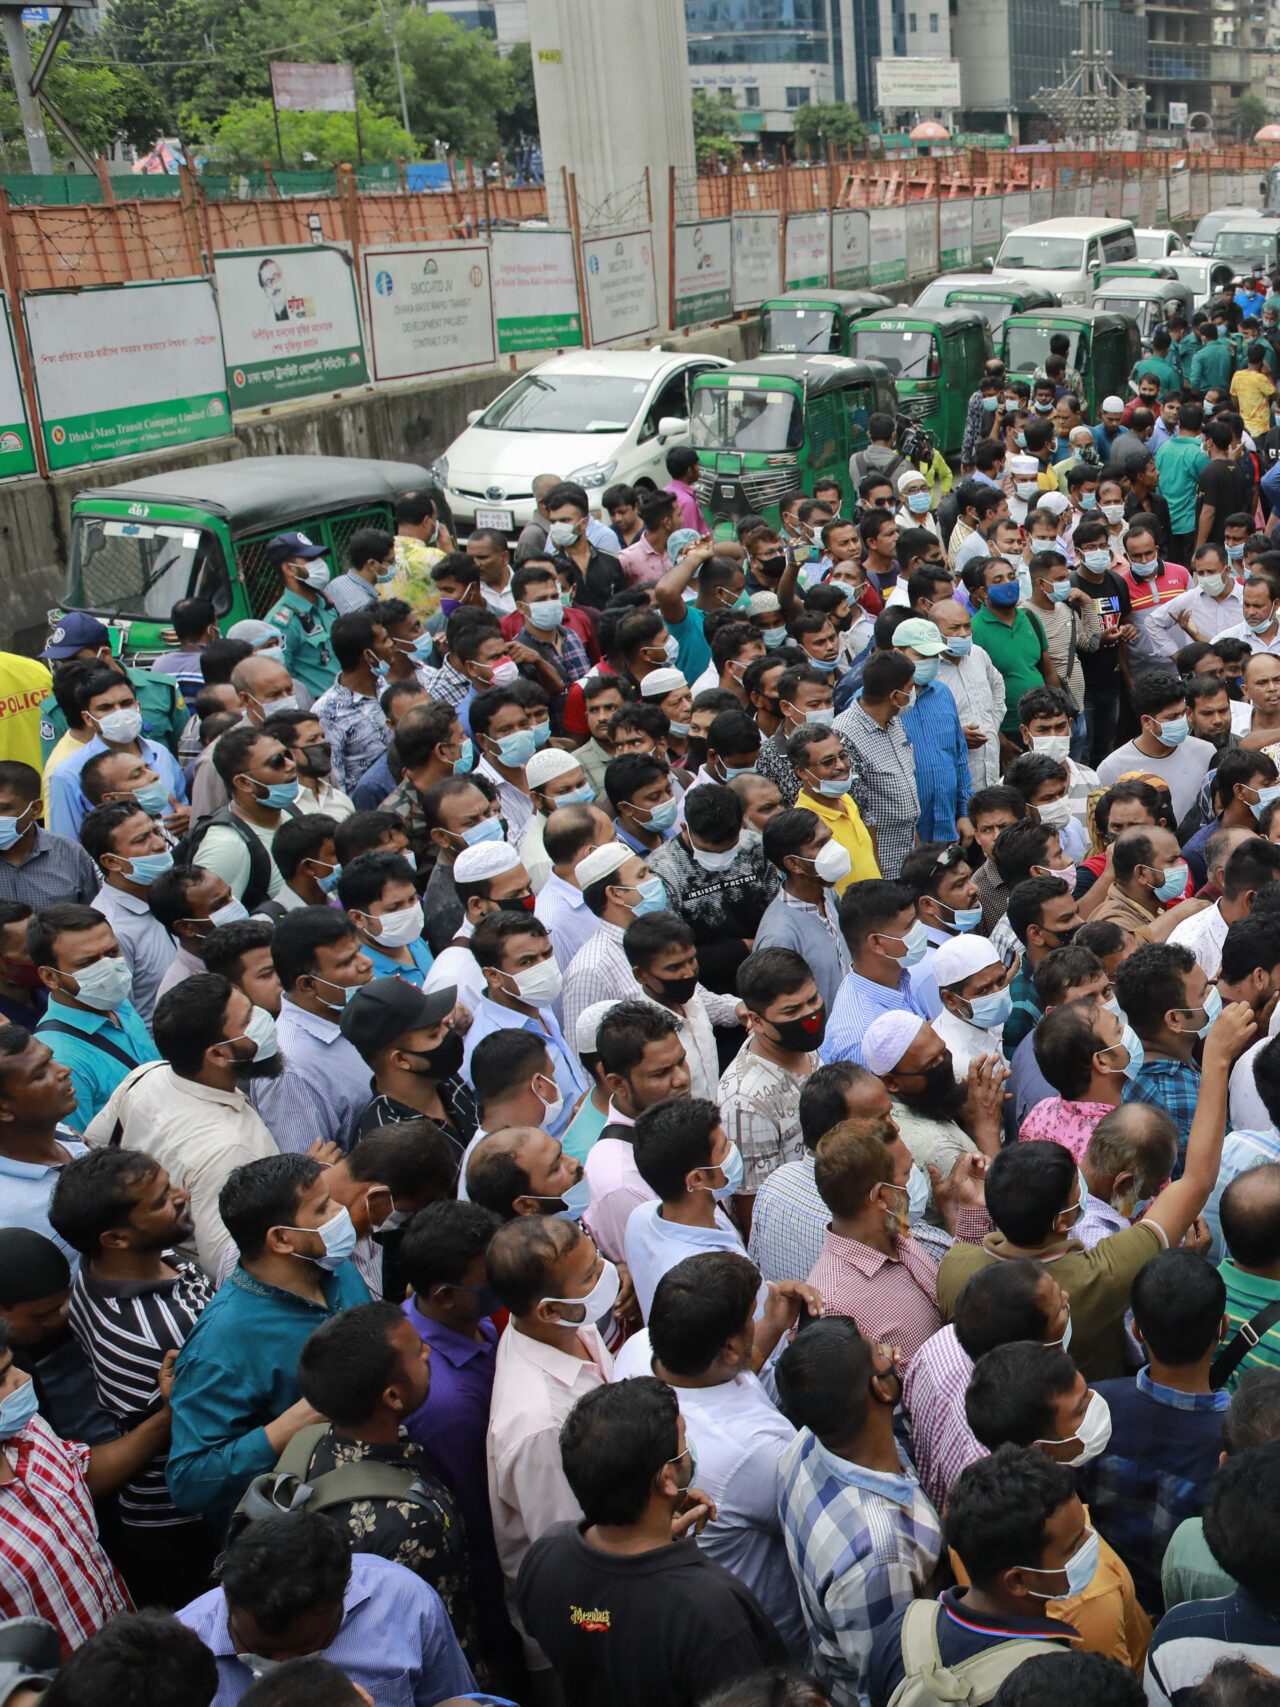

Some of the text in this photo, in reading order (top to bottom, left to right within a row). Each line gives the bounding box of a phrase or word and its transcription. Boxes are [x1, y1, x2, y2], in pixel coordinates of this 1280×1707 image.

[69, 411, 205, 443] Dhaka Mass Transit Company Limited
[0, 688, 49, 717] POLICE
[724, 874, 757, 888] FACTORY
